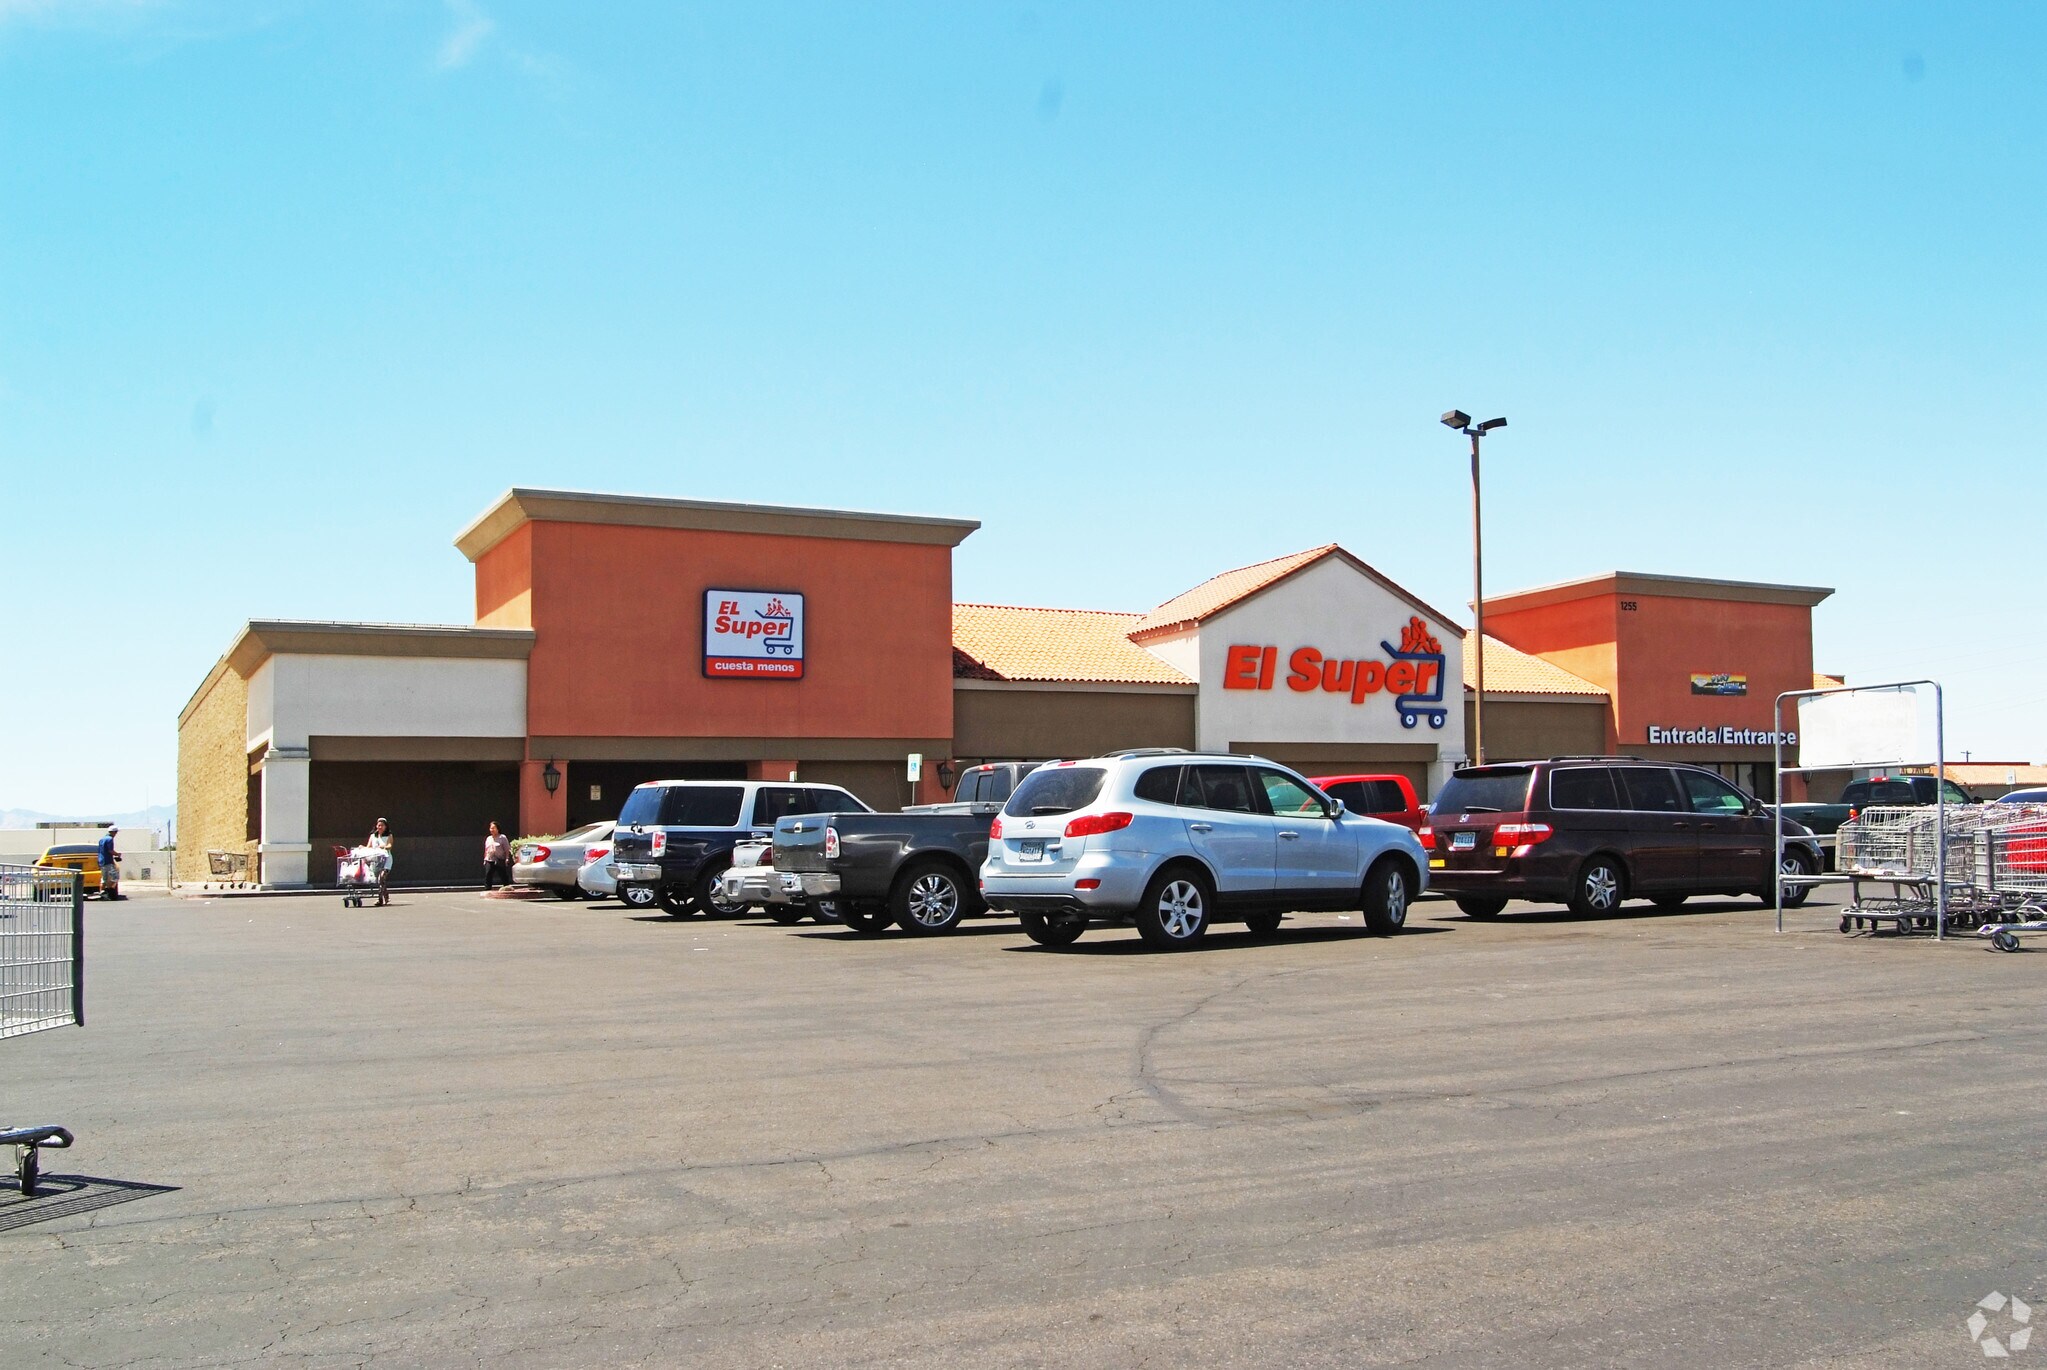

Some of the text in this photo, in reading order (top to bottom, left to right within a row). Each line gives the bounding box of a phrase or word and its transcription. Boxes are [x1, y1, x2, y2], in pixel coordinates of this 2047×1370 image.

[718, 601, 740, 615] EL
[1620, 601, 1637, 611] 1255
[715, 616, 789, 639] Super
[715, 662, 795, 672] cuesta menos
[1223, 645, 1439, 704] El Super
[1648, 726, 1796, 744] Entrada/Entrance
